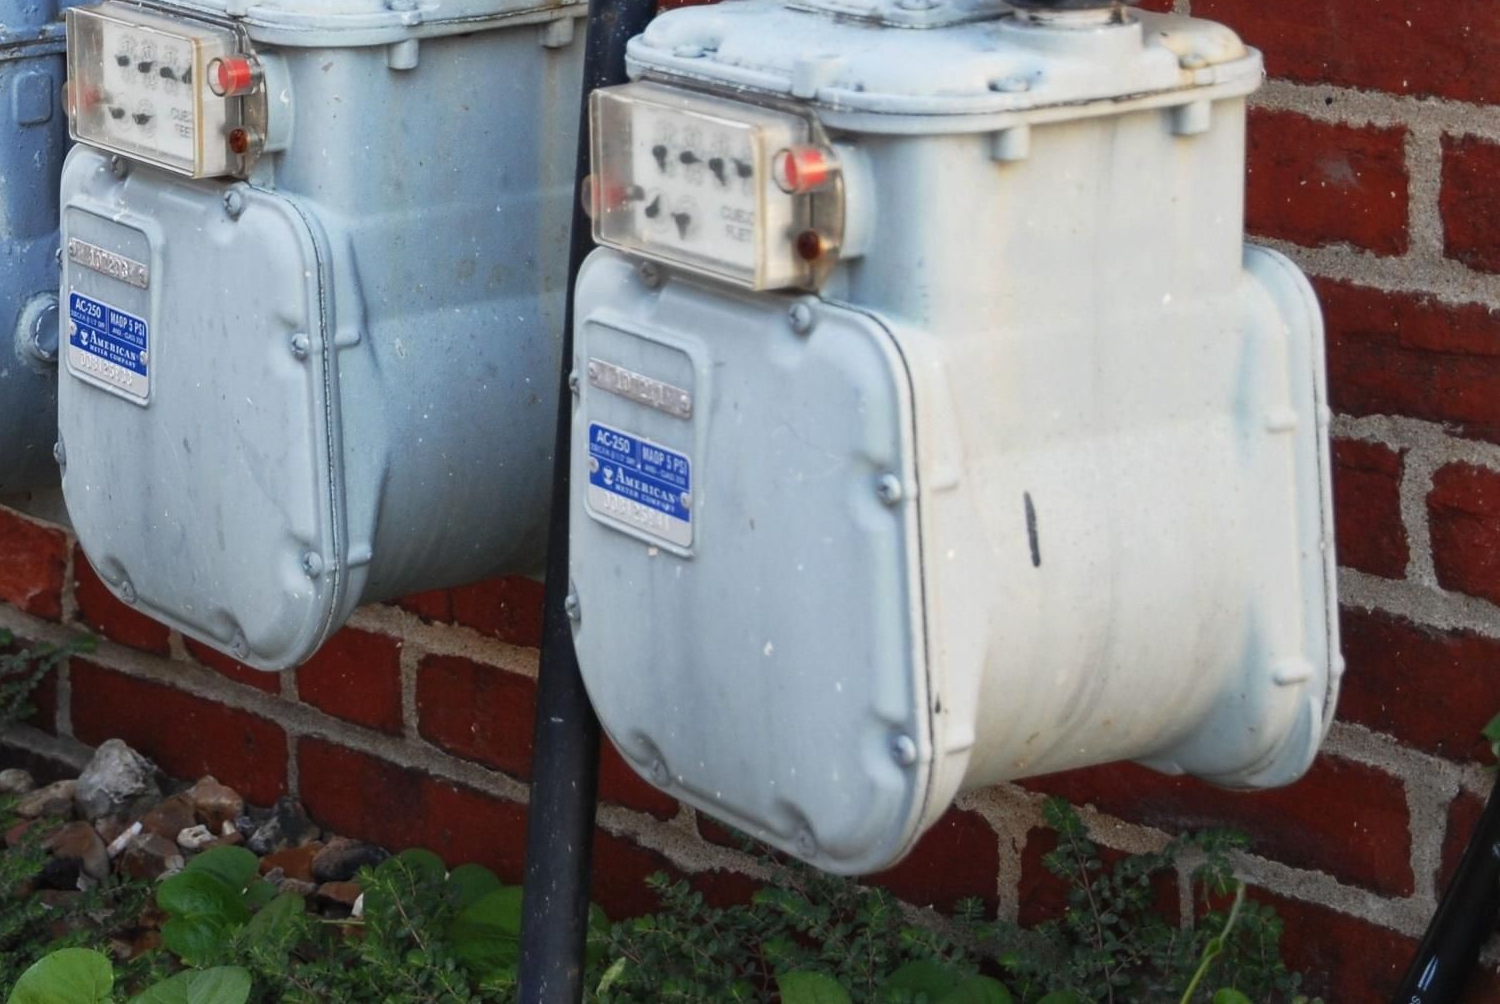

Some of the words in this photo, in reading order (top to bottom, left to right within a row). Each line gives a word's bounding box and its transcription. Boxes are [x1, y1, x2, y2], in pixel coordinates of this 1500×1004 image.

[75, 298, 101, 319] AC-250
[596, 429, 630, 454] AC-250
[666, 454, 672, 470] 5
